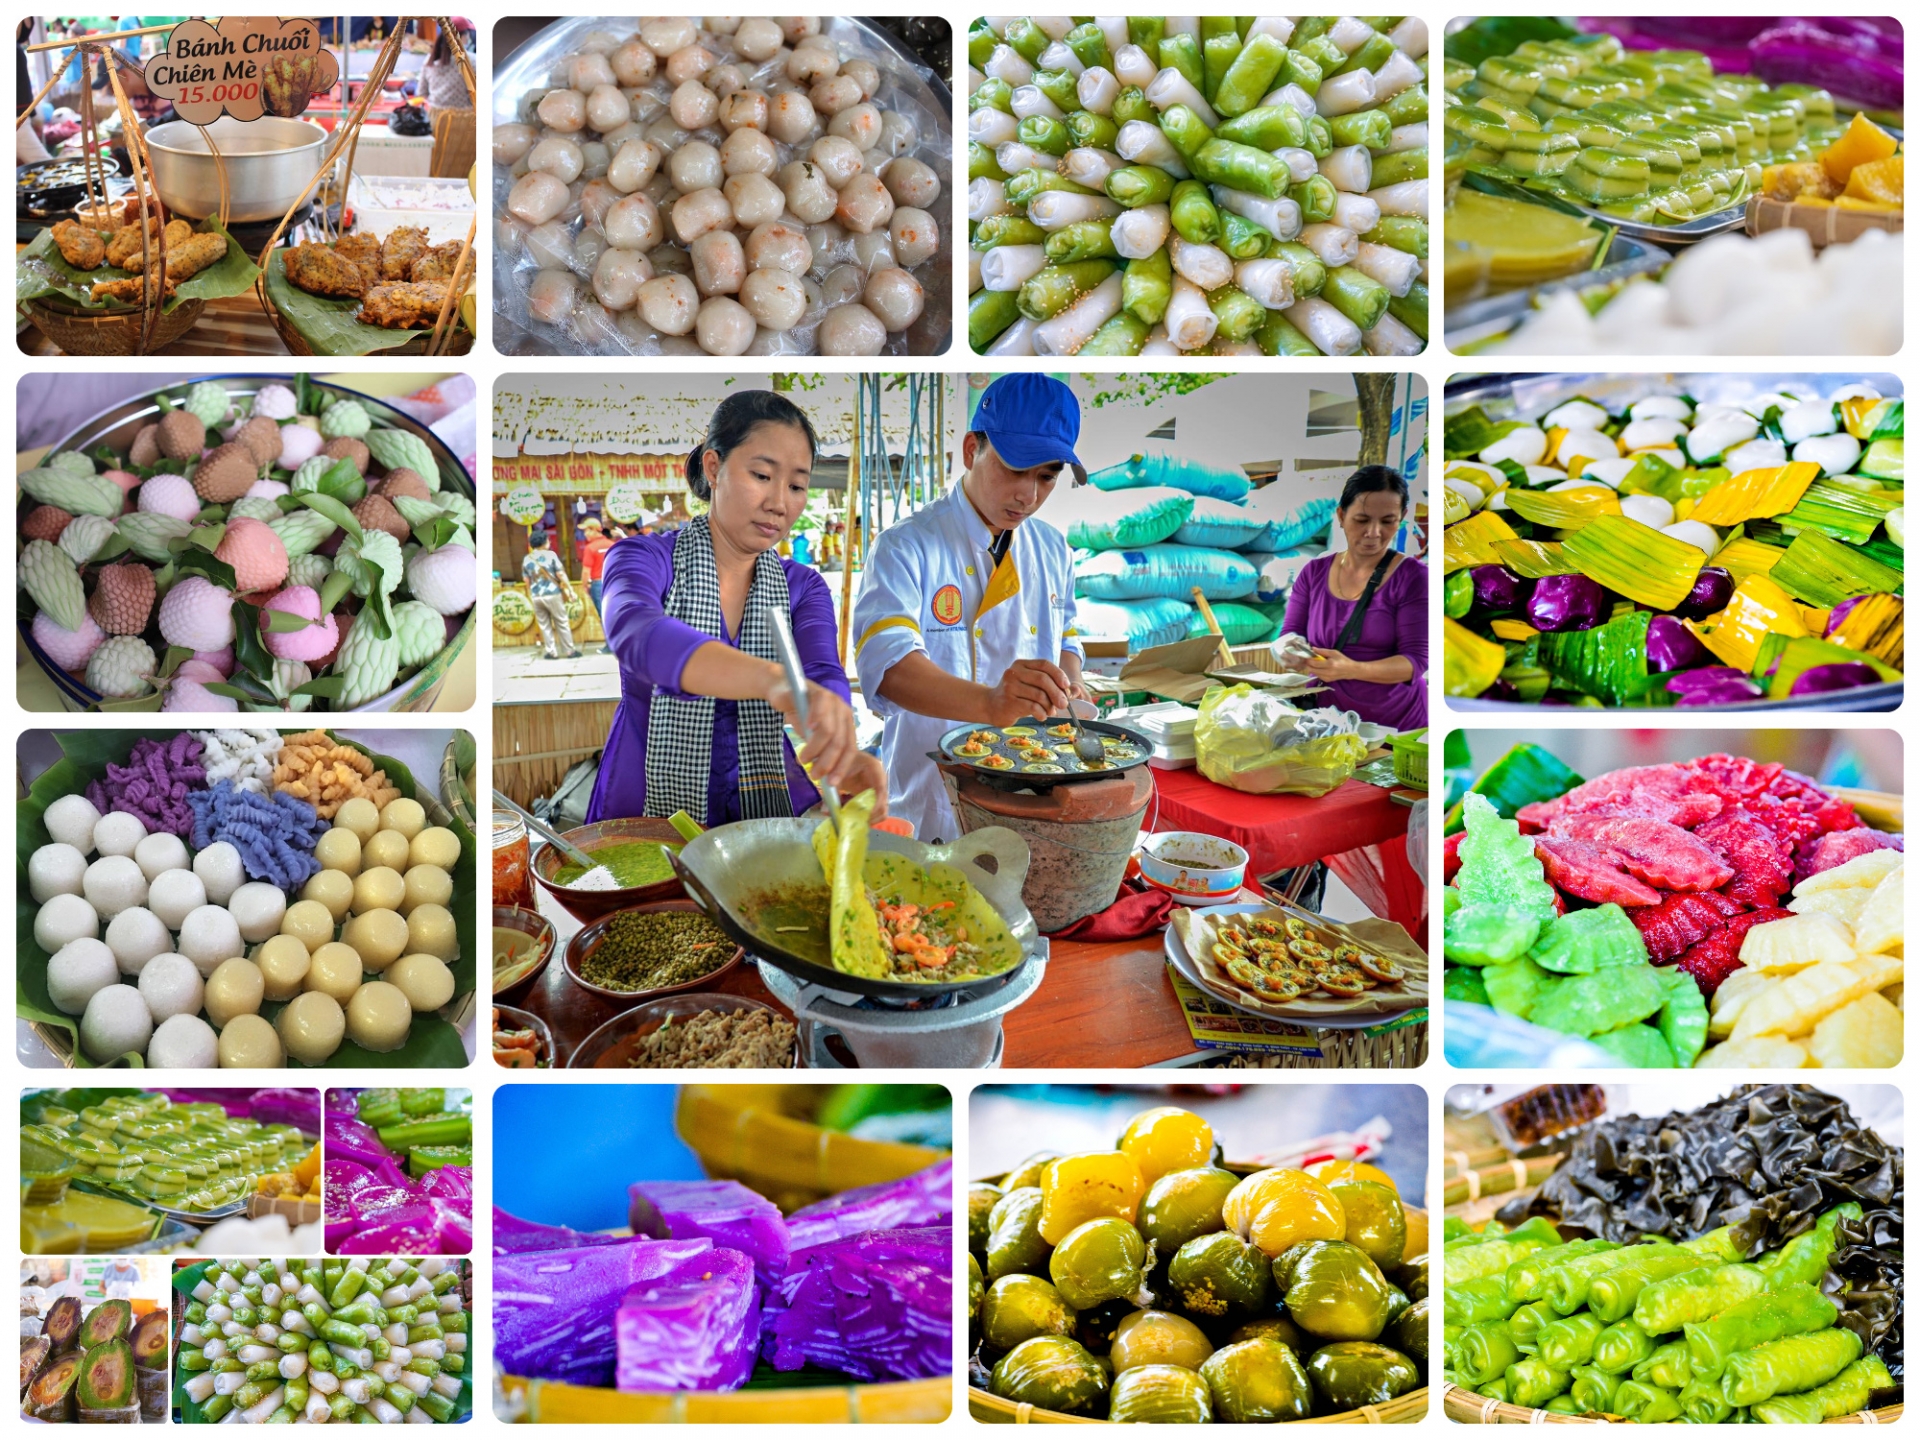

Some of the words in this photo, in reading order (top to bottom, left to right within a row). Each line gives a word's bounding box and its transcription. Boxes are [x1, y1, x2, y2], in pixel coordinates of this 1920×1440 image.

[176, 37, 236, 59] Bánh
[243, 27, 310, 53] Chuối
[153, 63, 217, 85] Chiên
[222, 60, 257, 80] Mè
[178, 82, 258, 104] 15.000
[608, 464, 639, 479] TNHH
